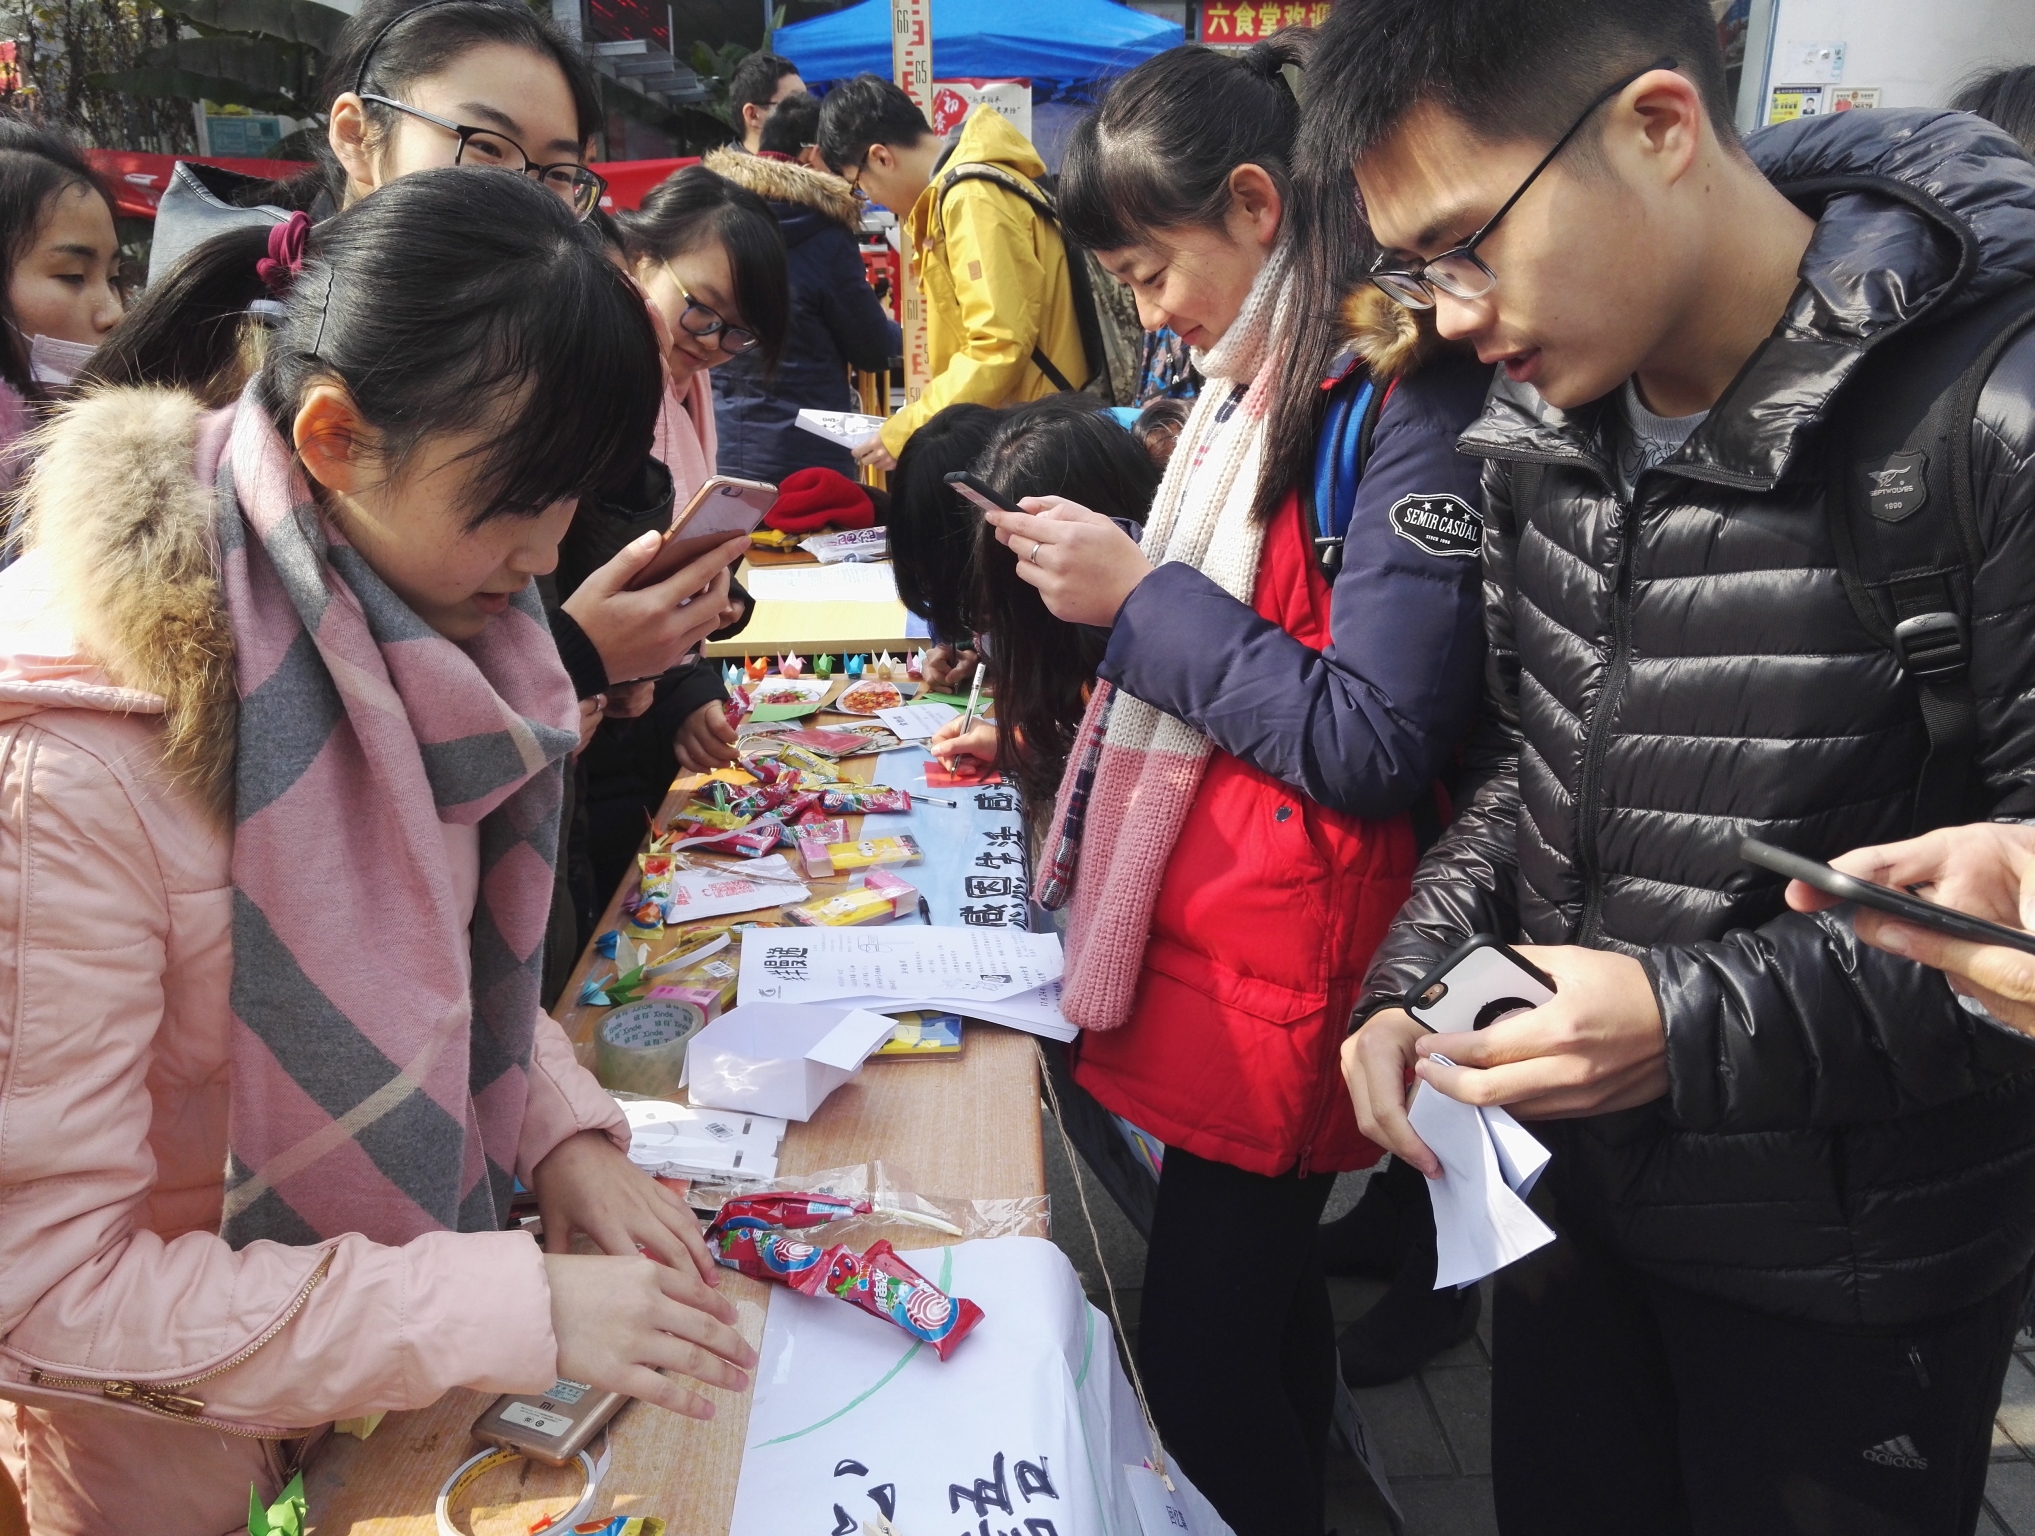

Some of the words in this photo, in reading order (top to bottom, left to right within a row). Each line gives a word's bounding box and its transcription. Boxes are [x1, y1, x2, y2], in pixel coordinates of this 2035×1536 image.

[896, 9, 909, 34] 66
[915, 60, 927, 84] 65
[907, 299, 918, 320] 60
[1869, 485, 1914, 497] SEPTWOLVES
[1884, 501, 1903, 510] 1990
[1403, 507, 1440, 530] SEMIR
[1438, 516, 1478, 542] CASUAL
[622, 1024, 642, 1035] Xinde
[642, 1029, 664, 1038] Xinde
[1863, 1450, 1928, 1470] adidas
